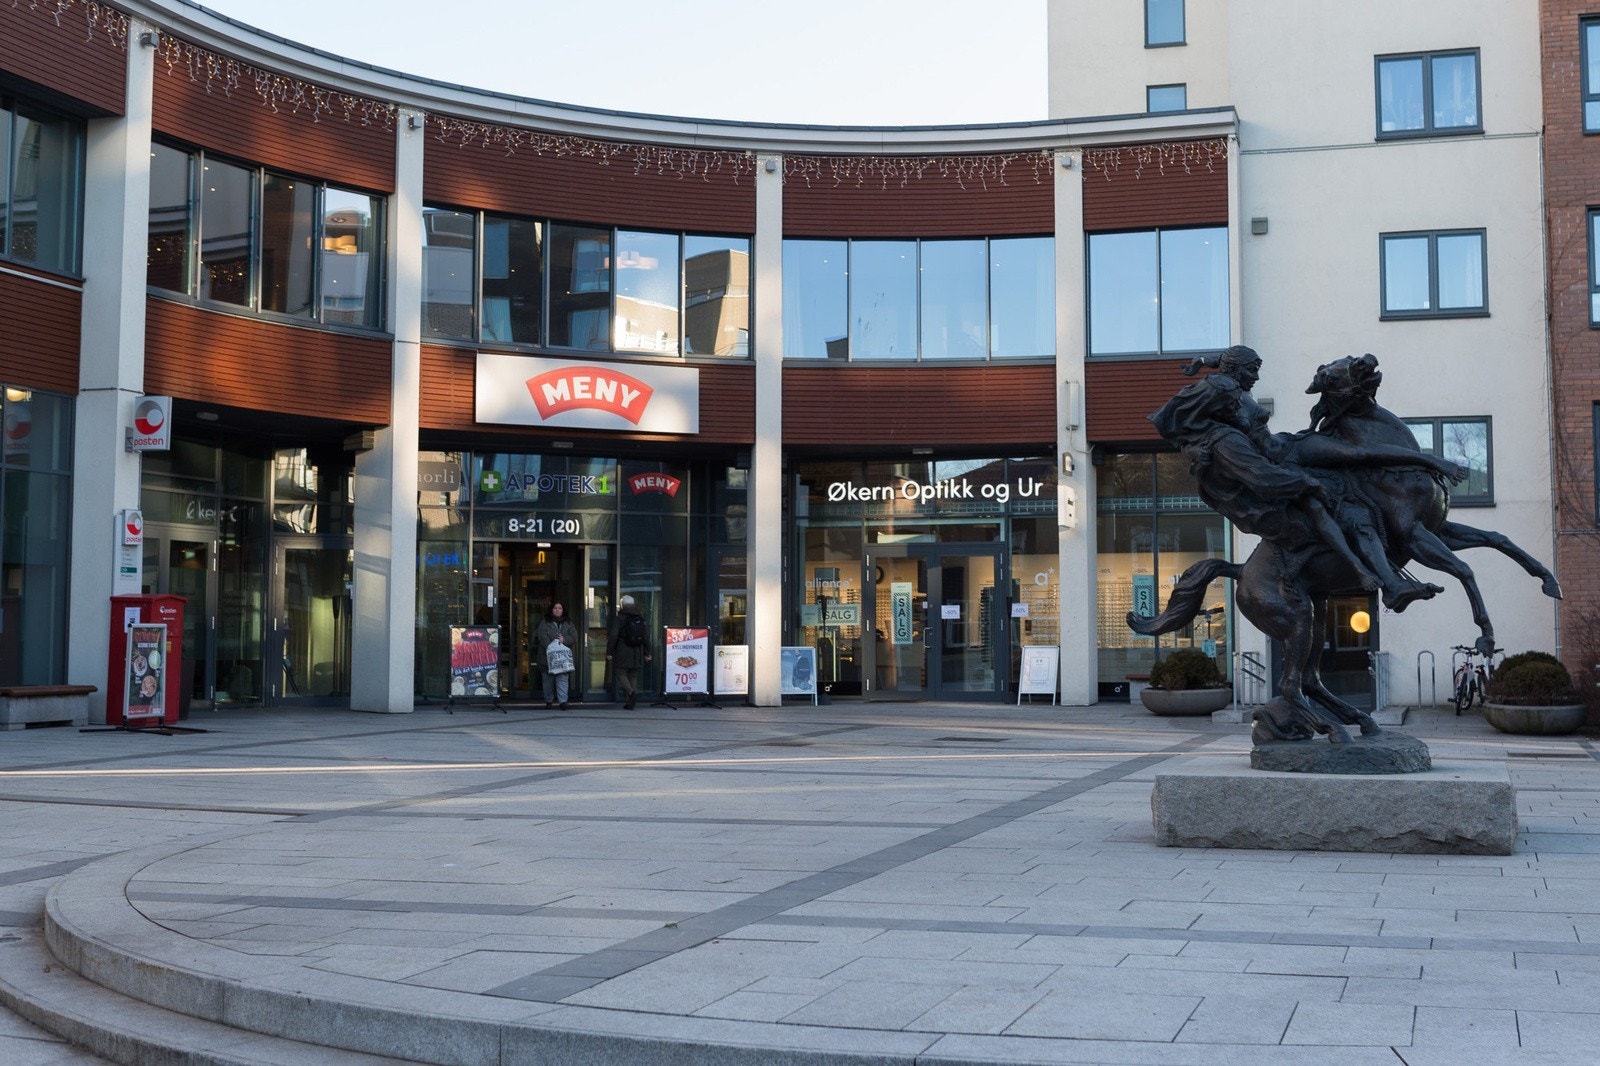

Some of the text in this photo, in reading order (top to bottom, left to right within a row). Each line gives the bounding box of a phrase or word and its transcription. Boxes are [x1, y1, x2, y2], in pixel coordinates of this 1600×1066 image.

[541, 376, 641, 409] MENY
[133, 437, 164, 446] posten
[634, 476, 675, 490] MENY
[827, 477, 1044, 504] Økern Optikk og Ur
[508, 518, 580, 535] 8-21 (20)
[824, 610, 852, 619] SALG
[898, 598, 907, 637] SALG
[667, 628, 694, 643] -53%
